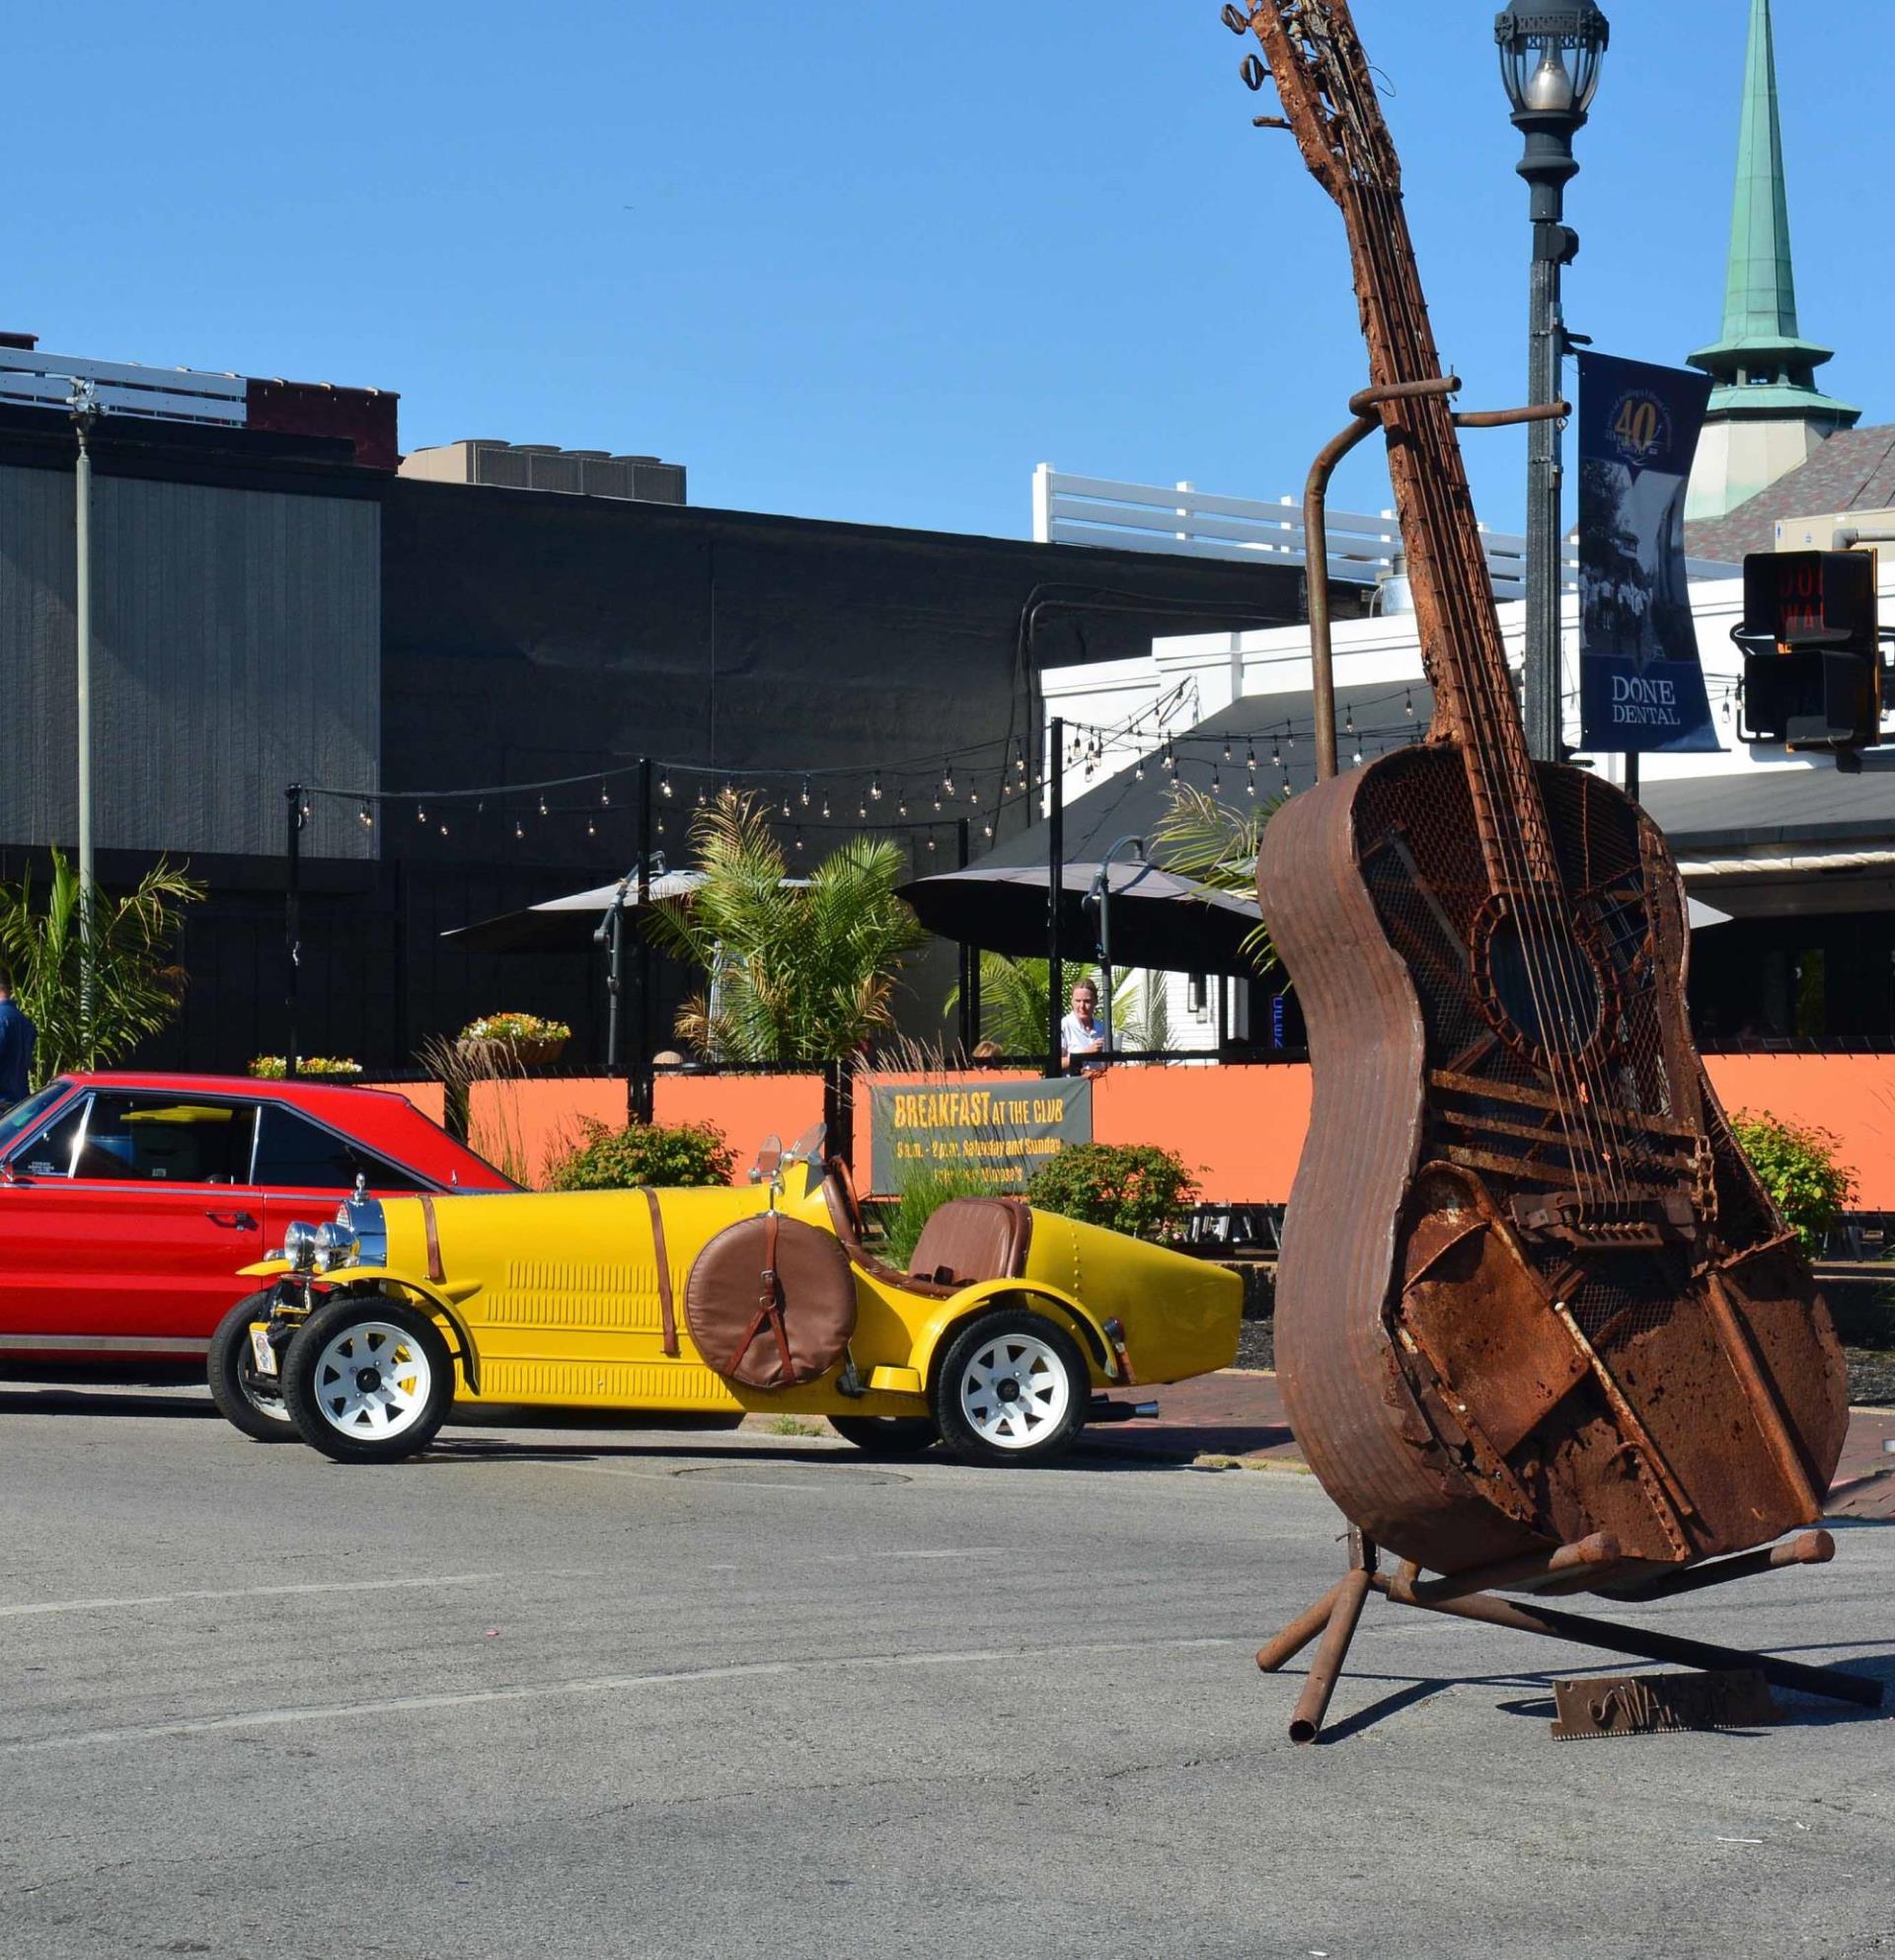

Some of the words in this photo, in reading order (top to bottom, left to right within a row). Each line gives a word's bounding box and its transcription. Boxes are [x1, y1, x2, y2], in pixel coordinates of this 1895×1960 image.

[1614, 399, 1657, 450] 40
[1778, 600, 1831, 633] WAL
[1611, 675, 1676, 705] DONE
[1612, 704, 1681, 725] DENTAL
[894, 1092, 991, 1128] BREAKFAST
[992, 1101, 1005, 1125] AT
[1009, 1100, 1029, 1124] THE
[1033, 1097, 1063, 1123] CLUB
[1005, 1138, 1024, 1156] and
[1024, 1136, 1061, 1155] Sunday
